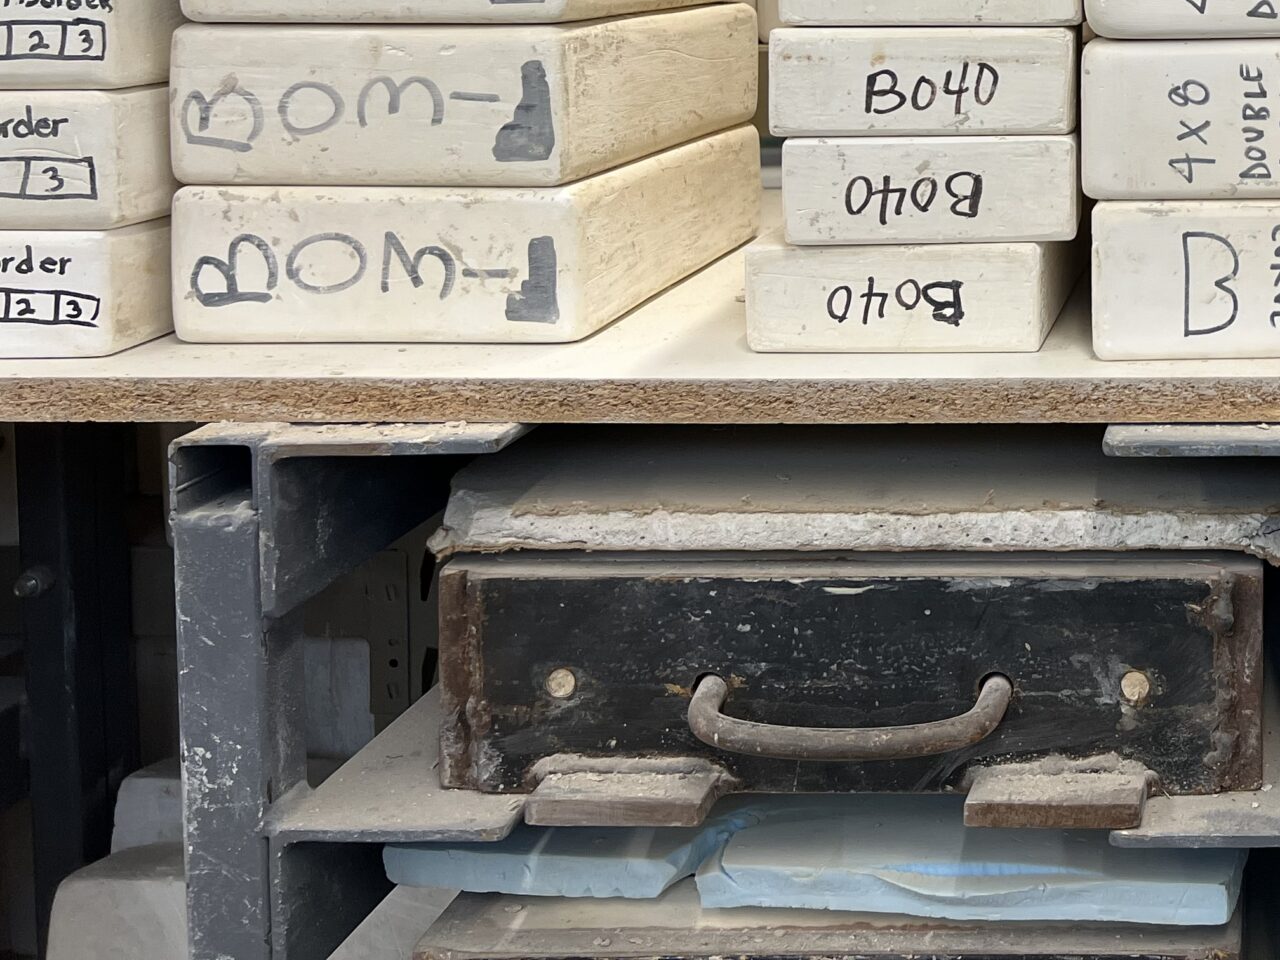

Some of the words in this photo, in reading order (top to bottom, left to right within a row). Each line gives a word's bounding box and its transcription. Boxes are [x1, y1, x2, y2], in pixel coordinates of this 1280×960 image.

[28, 29, 51, 52] 2
[78, 28, 95, 54] 3
[1238, 63, 1271, 180] DOUBLE
[17, 297, 37, 318] 2
[66, 298, 83, 321] 3
